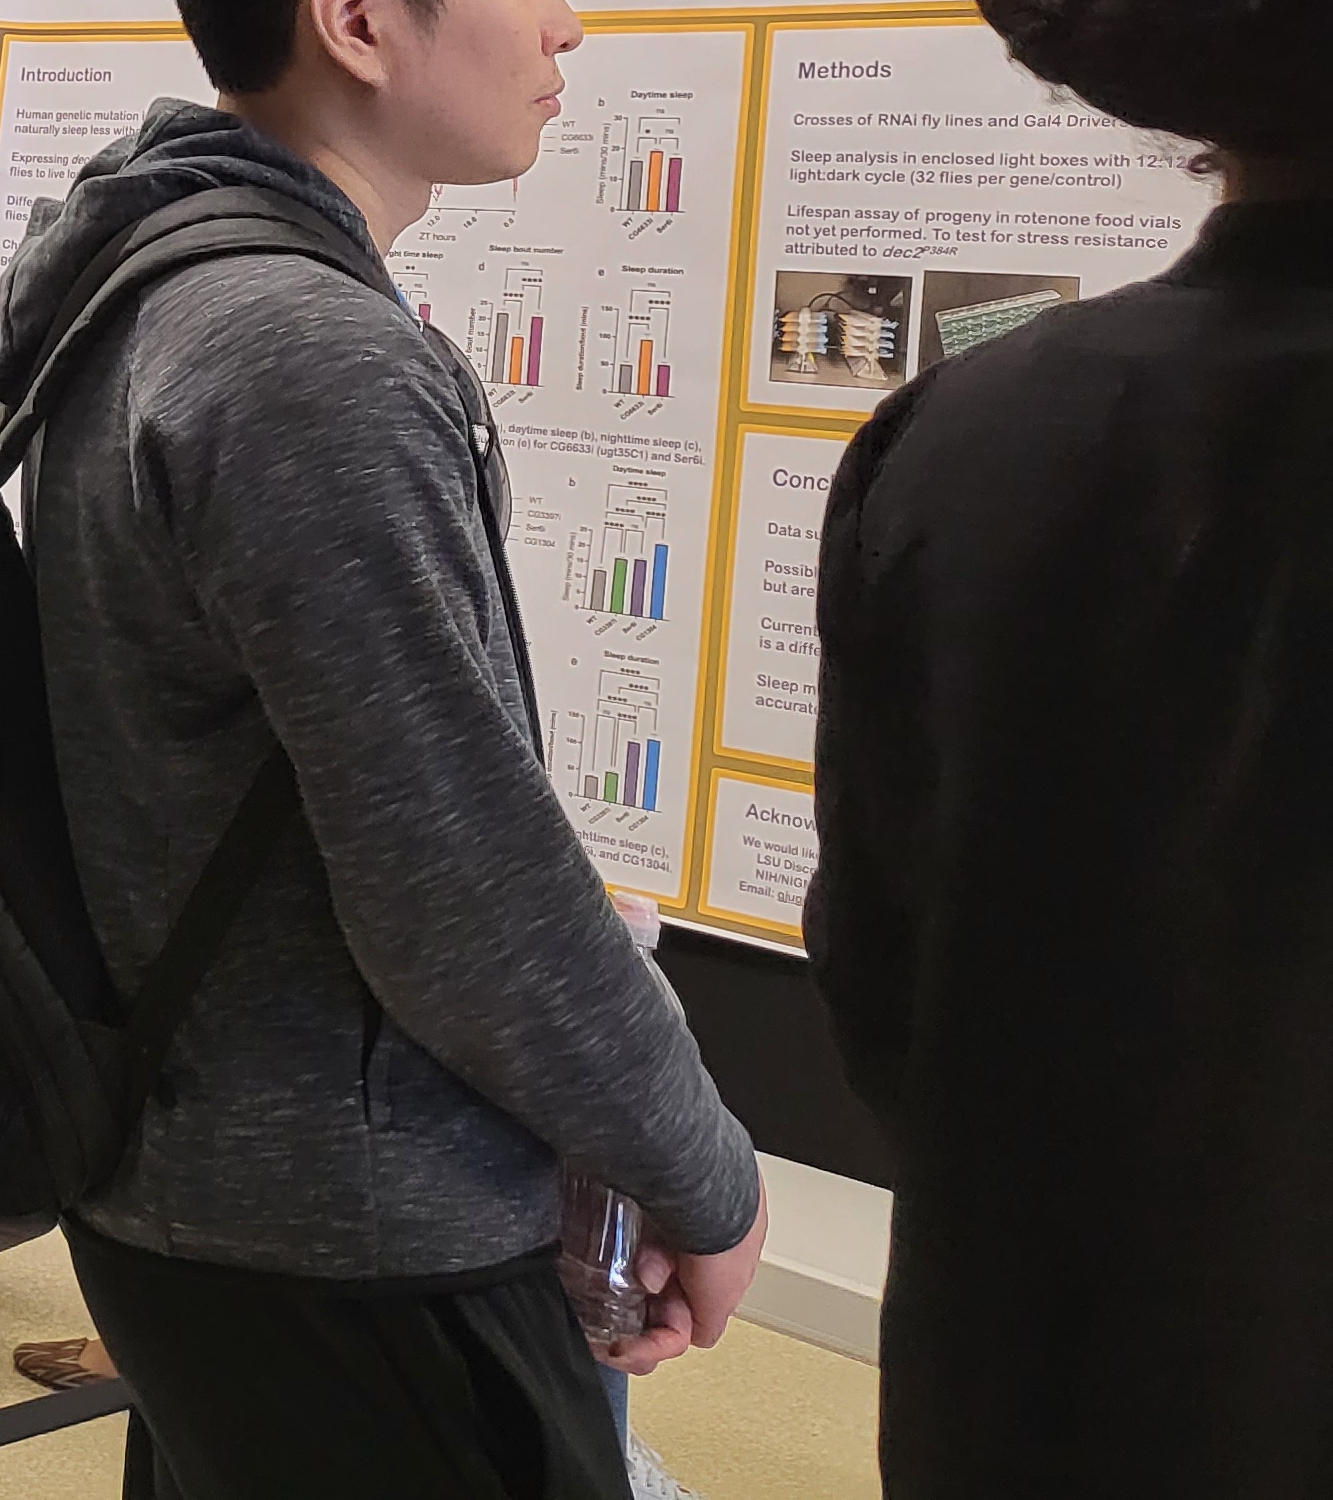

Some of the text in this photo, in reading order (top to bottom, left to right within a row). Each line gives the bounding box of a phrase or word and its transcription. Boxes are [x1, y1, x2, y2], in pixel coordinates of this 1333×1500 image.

[21, 67, 112, 83] Introduction
[798, 61, 892, 79] Methods
[631, 90, 667, 100] Daytime
[16, 109, 53, 120] Human
[56, 110, 92, 125] genetic
[94, 109, 139, 120] mutation
[793, 113, 853, 127] Crosses
[858, 113, 873, 127] of
[878, 114, 917, 127] RNAi
[922, 114, 941, 129] fly
[946, 114, 983, 128] lines
[988, 115, 1019, 128] and
[1024, 114, 1061, 128] Gal4
[14, 124, 110, 137] naturally sleep less
[12, 152, 68, 165] Expressing
[791, 150, 1131, 170] Sleep analysis in enclosed light boxes with
[10, 167, 33, 177] flies
[36, 169, 45, 178] to
[48, 168, 65, 179] live
[789, 169, 1122, 190] light:dark cycle (32 flies per gene/control)
[5, 210, 28, 221] flies
[787, 205, 1182, 231] Lifespan assay of progeny in rotenone food vials
[786, 225, 1168, 250] not yet performed. To test for stress resistance
[785, 242, 878, 258] attributed to
[508, 424, 548, 439] daytime
[551, 428, 578, 441] sleep
[601, 432, 650, 446] nighttime
[653, 437, 681, 449] sleep
[533, 440, 548, 449] for
[651, 451, 671, 463] and
[768, 522, 801, 538] Data
[765, 560, 817, 578] Possibl
[763, 579, 815, 598] but are
[759, 636, 785, 650] is a
[757, 674, 799, 695] Sleep
[755, 695, 817, 715] accurat
[576, 830, 616, 846] ghttime
[619, 839, 648, 854] sleep
[743, 835, 761, 847] We
[764, 840, 798, 857] would
[599, 850, 620, 861] and
[757, 853, 781, 867] LSU
[739, 881, 774, 898] Email:
